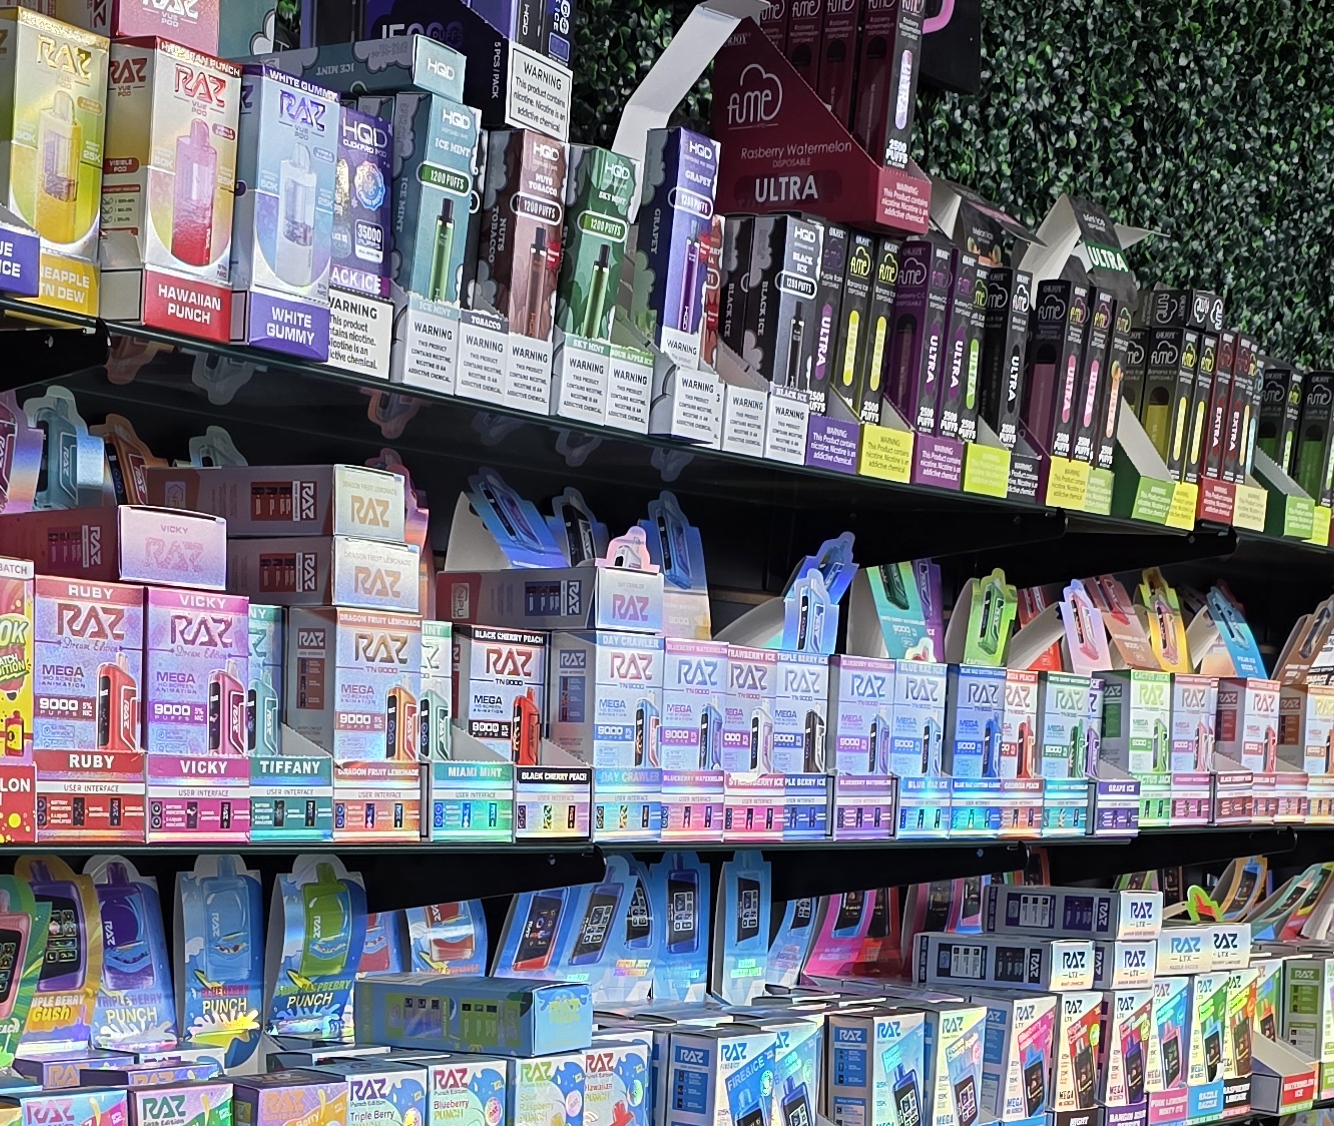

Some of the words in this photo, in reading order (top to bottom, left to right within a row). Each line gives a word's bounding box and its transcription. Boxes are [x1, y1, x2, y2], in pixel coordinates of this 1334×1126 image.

[493, 50, 501, 66] PCS
[428, 57, 456, 81] HQD
[524, 61, 562, 90] WARNING
[491, 73, 500, 98] PACK
[516, 77, 526, 89] This
[527, 83, 545, 98] product
[547, 91, 566, 108] contains
[514, 91, 535, 107] nicotine.
[536, 100, 554, 116] Nicotine
[442, 109, 471, 129] HQD
[517, 106, 539, 123] addictive
[540, 116, 561, 133] chemical.
[342, 118, 388, 148] HQD
[435, 138, 448, 149] ICE
[450, 142, 471, 157] MINT
[741, 144, 785, 160] Rasberry
[787, 140, 852, 156] Watermelon
[773, 158, 811, 168] DISPOSABLE
[430, 169, 445, 183] 1200
[446, 173, 464, 190] PUFFS
[755, 175, 818, 203] ULTRA
[158, 283, 221, 311] HAWAIIAN
[168, 301, 210, 325] PUNCH
[271, 307, 311, 328] WHITE
[266, 321, 315, 345] GUMMY
[466, 334, 503, 353] WARNING
[69, 753, 115, 770] RUBY
[180, 760, 227, 774] VICKY
[260, 760, 321, 774] TIFFANY
[448, 767, 478, 778] MIAMI
[481, 767, 502, 778] MINT
